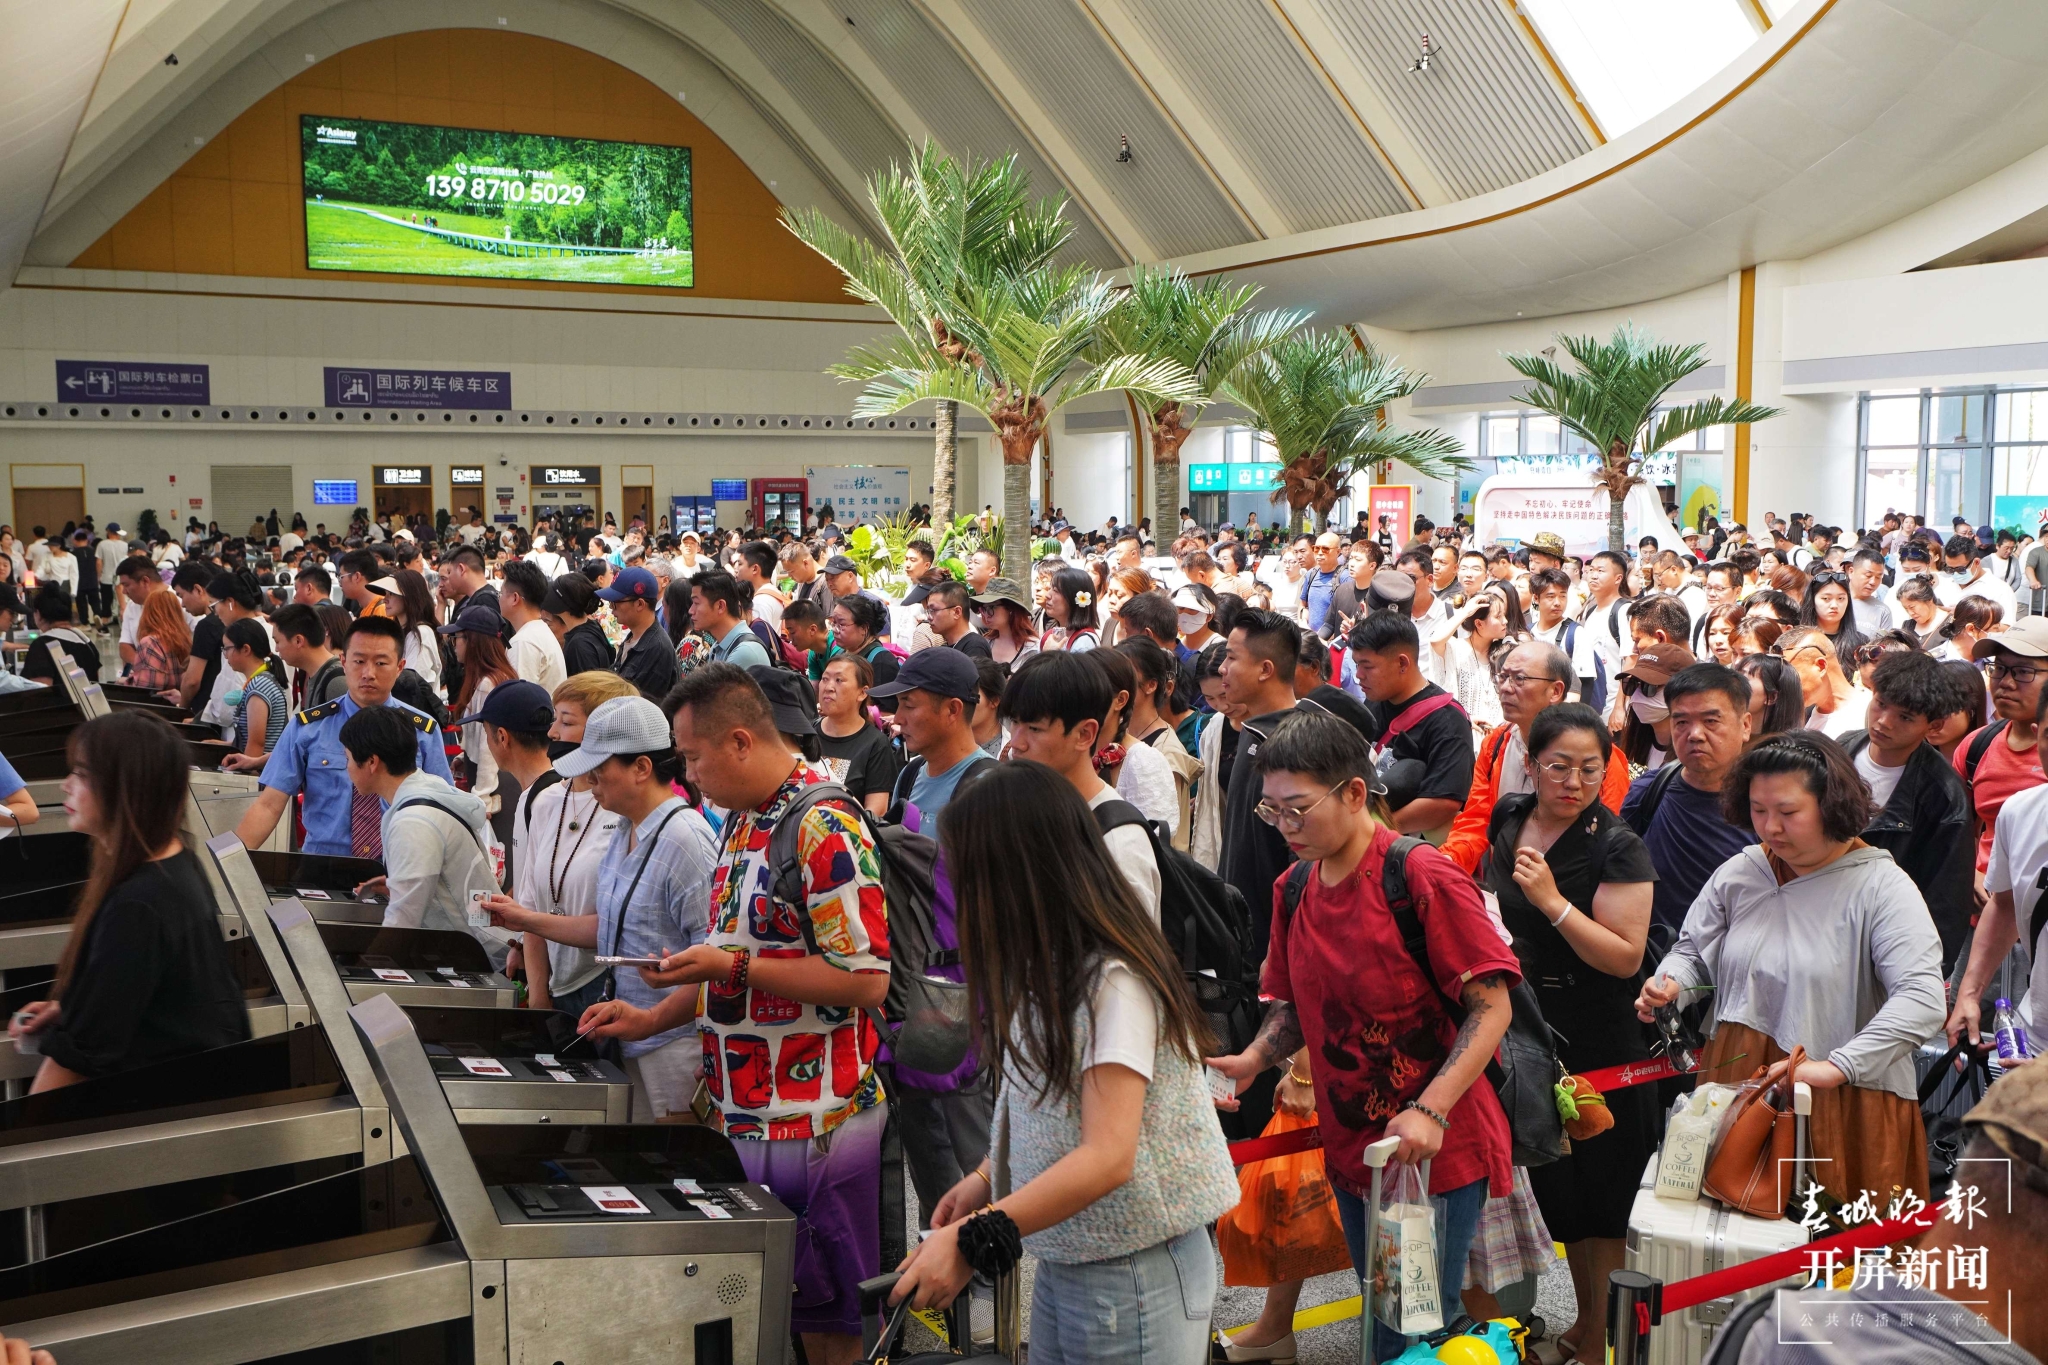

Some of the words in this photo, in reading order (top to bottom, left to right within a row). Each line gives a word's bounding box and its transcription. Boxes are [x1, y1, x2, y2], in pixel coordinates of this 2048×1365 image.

[426, 174, 466, 198] 139
[470, 178, 525, 202] 8710
[530, 182, 586, 206] 5029
[118, 370, 203, 384] 国际列车检票口
[376, 373, 499, 393] 国际列车候车区
[559, 469, 580, 478] 饮用水
[815, 497, 832, 505] 富强
[838, 497, 855, 505] 民主
[862, 497, 878, 505] 文明
[884, 497, 900, 505] 和谐
[1525, 500, 1592, 508] 不忘初心、牢记使命
[757, 1007, 794, 1017] FREE
[1634, 1064, 1662, 1077] 中老铁路
[1665, 1163, 1698, 1174] COFFEE
[1663, 1175, 1695, 1190] NATURAL
[1404, 1282, 1433, 1295] COFFEE
